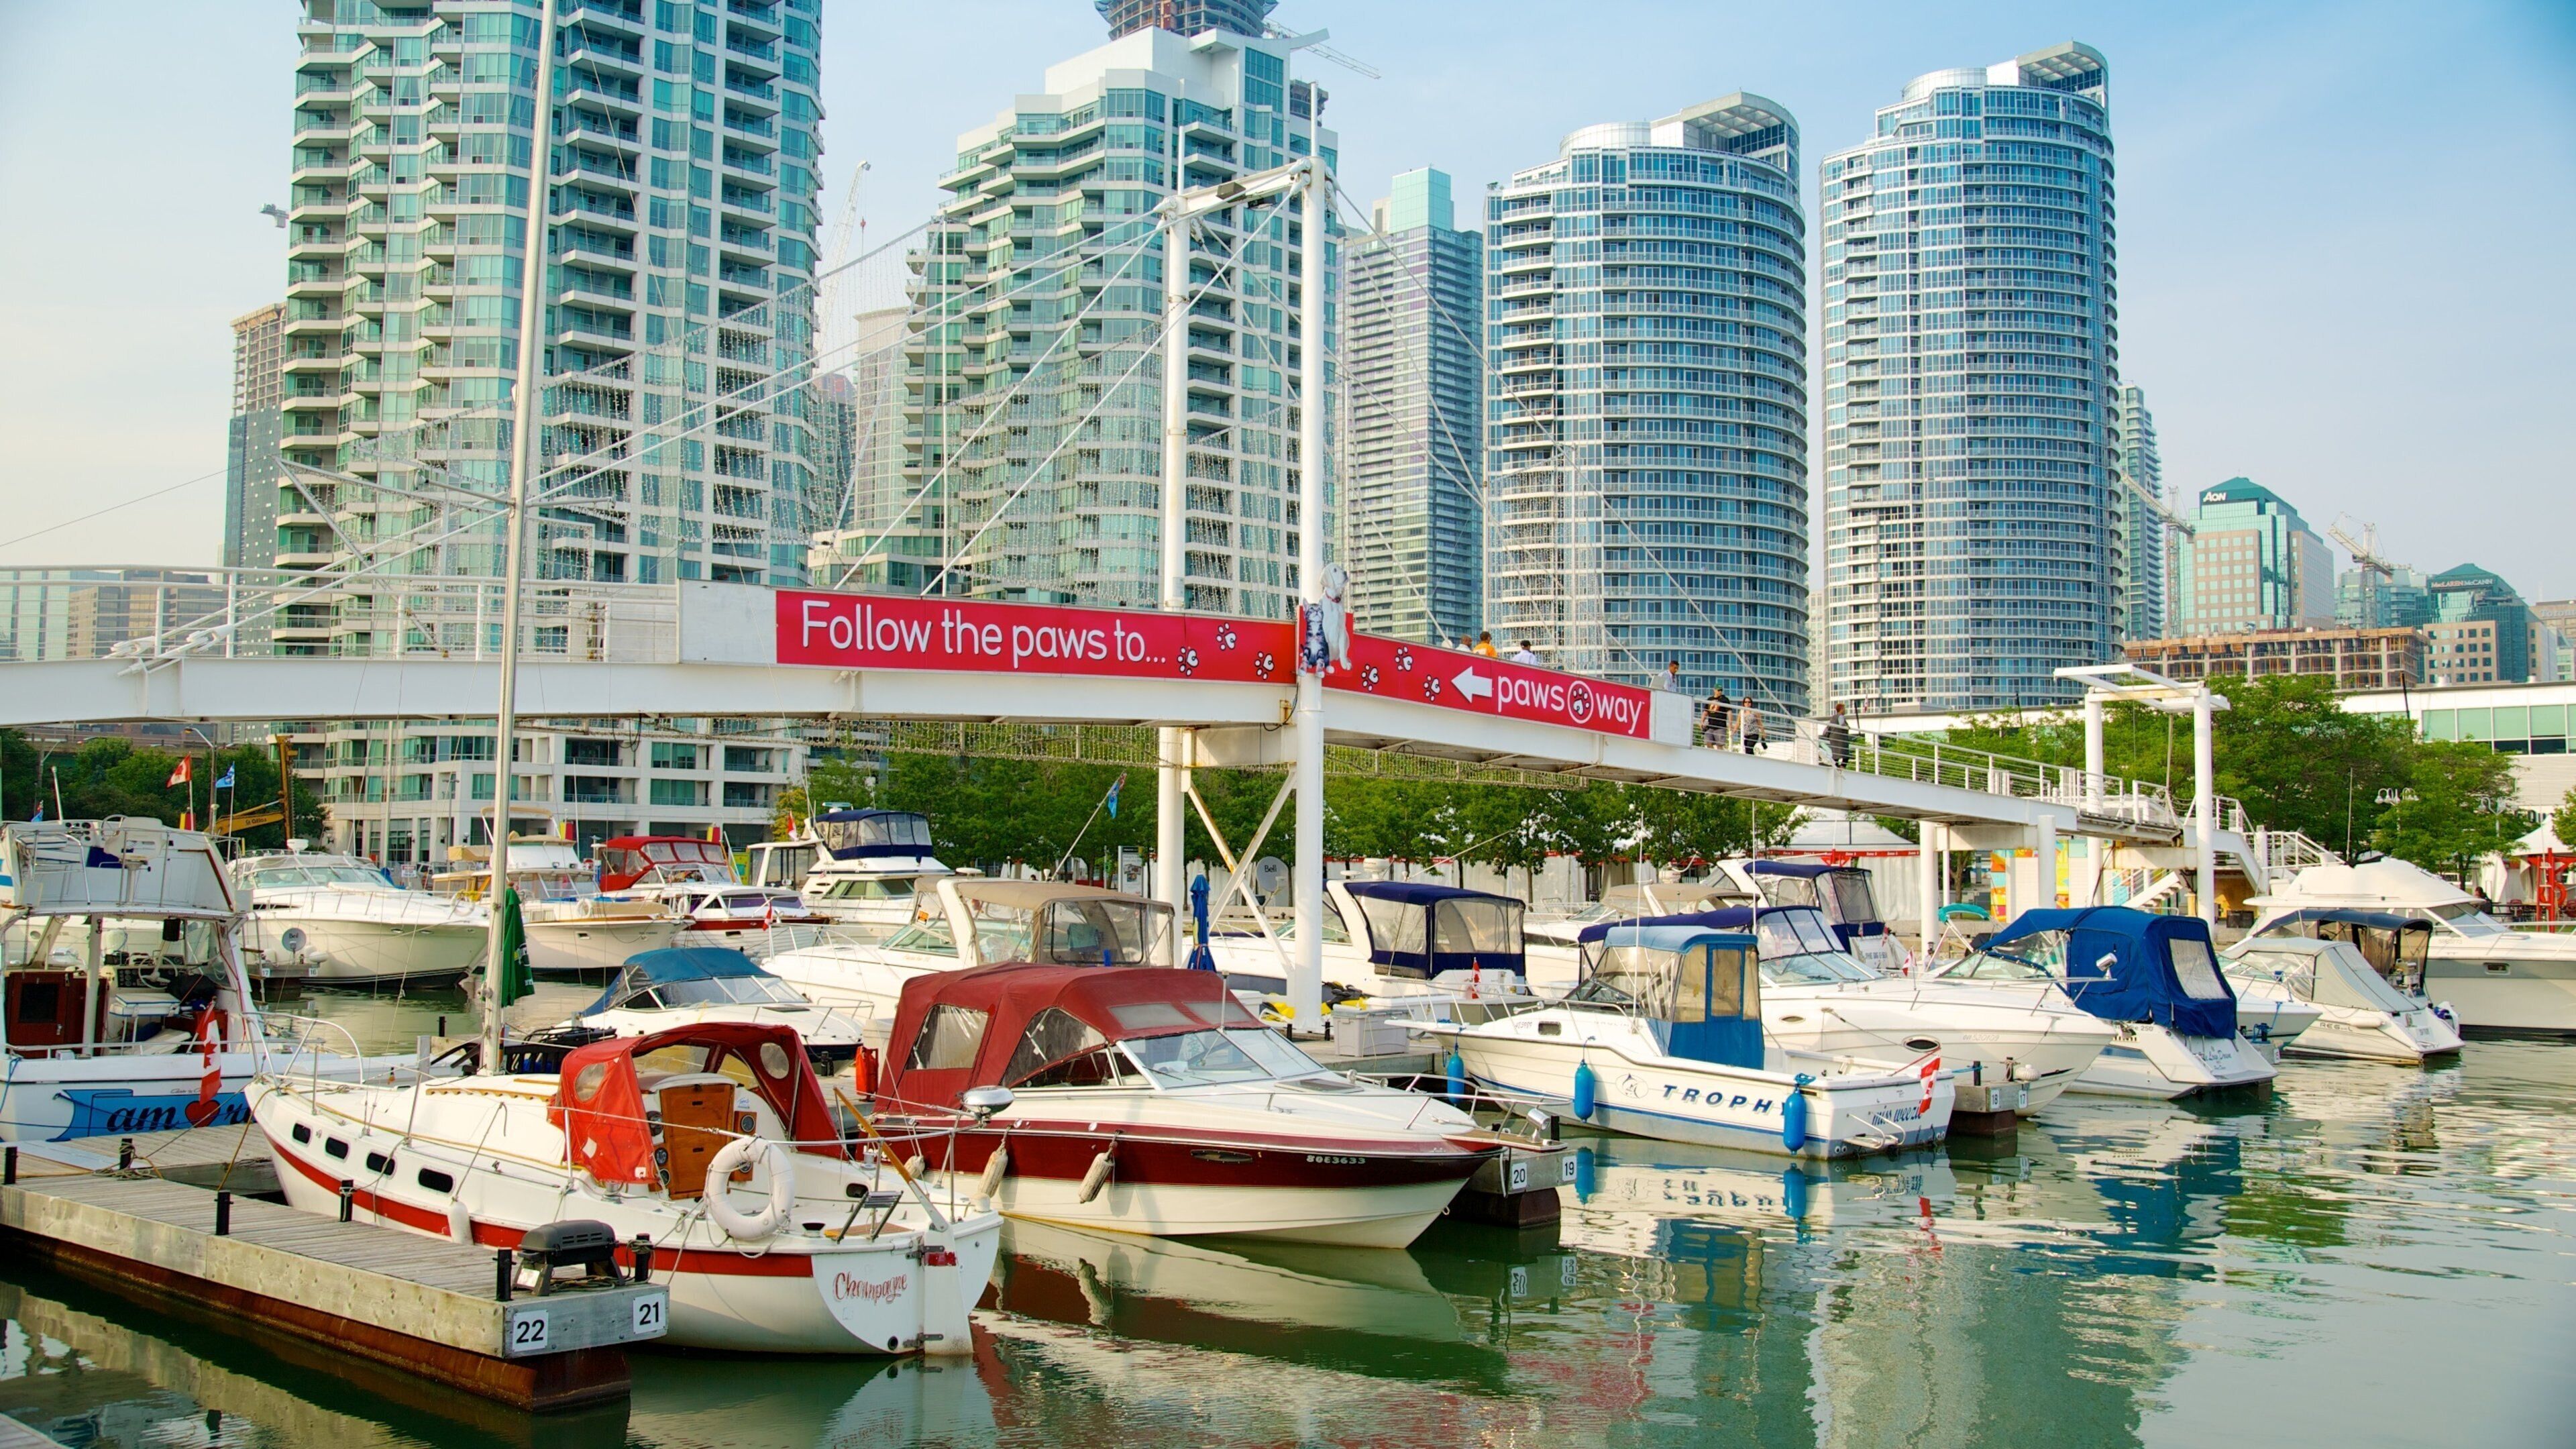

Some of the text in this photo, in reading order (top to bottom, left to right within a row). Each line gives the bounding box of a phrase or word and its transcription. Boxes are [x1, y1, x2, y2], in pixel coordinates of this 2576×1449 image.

[2202, 492, 2226, 502] AON
[803, 600, 1166, 669] Follow the paws to...
[1498, 676, 1644, 735] paws way
[1265, 864, 1277, 873] Bell
[1992, 1094, 1998, 1106] 18
[2020, 1093, 2026, 1104] 17
[107, 1106, 181, 1132] am
[1513, 1169, 1525, 1183] 20
[1564, 1162, 1574, 1176] 19
[639, 1301, 659, 1326] 21
[516, 1320, 545, 1344] 22
